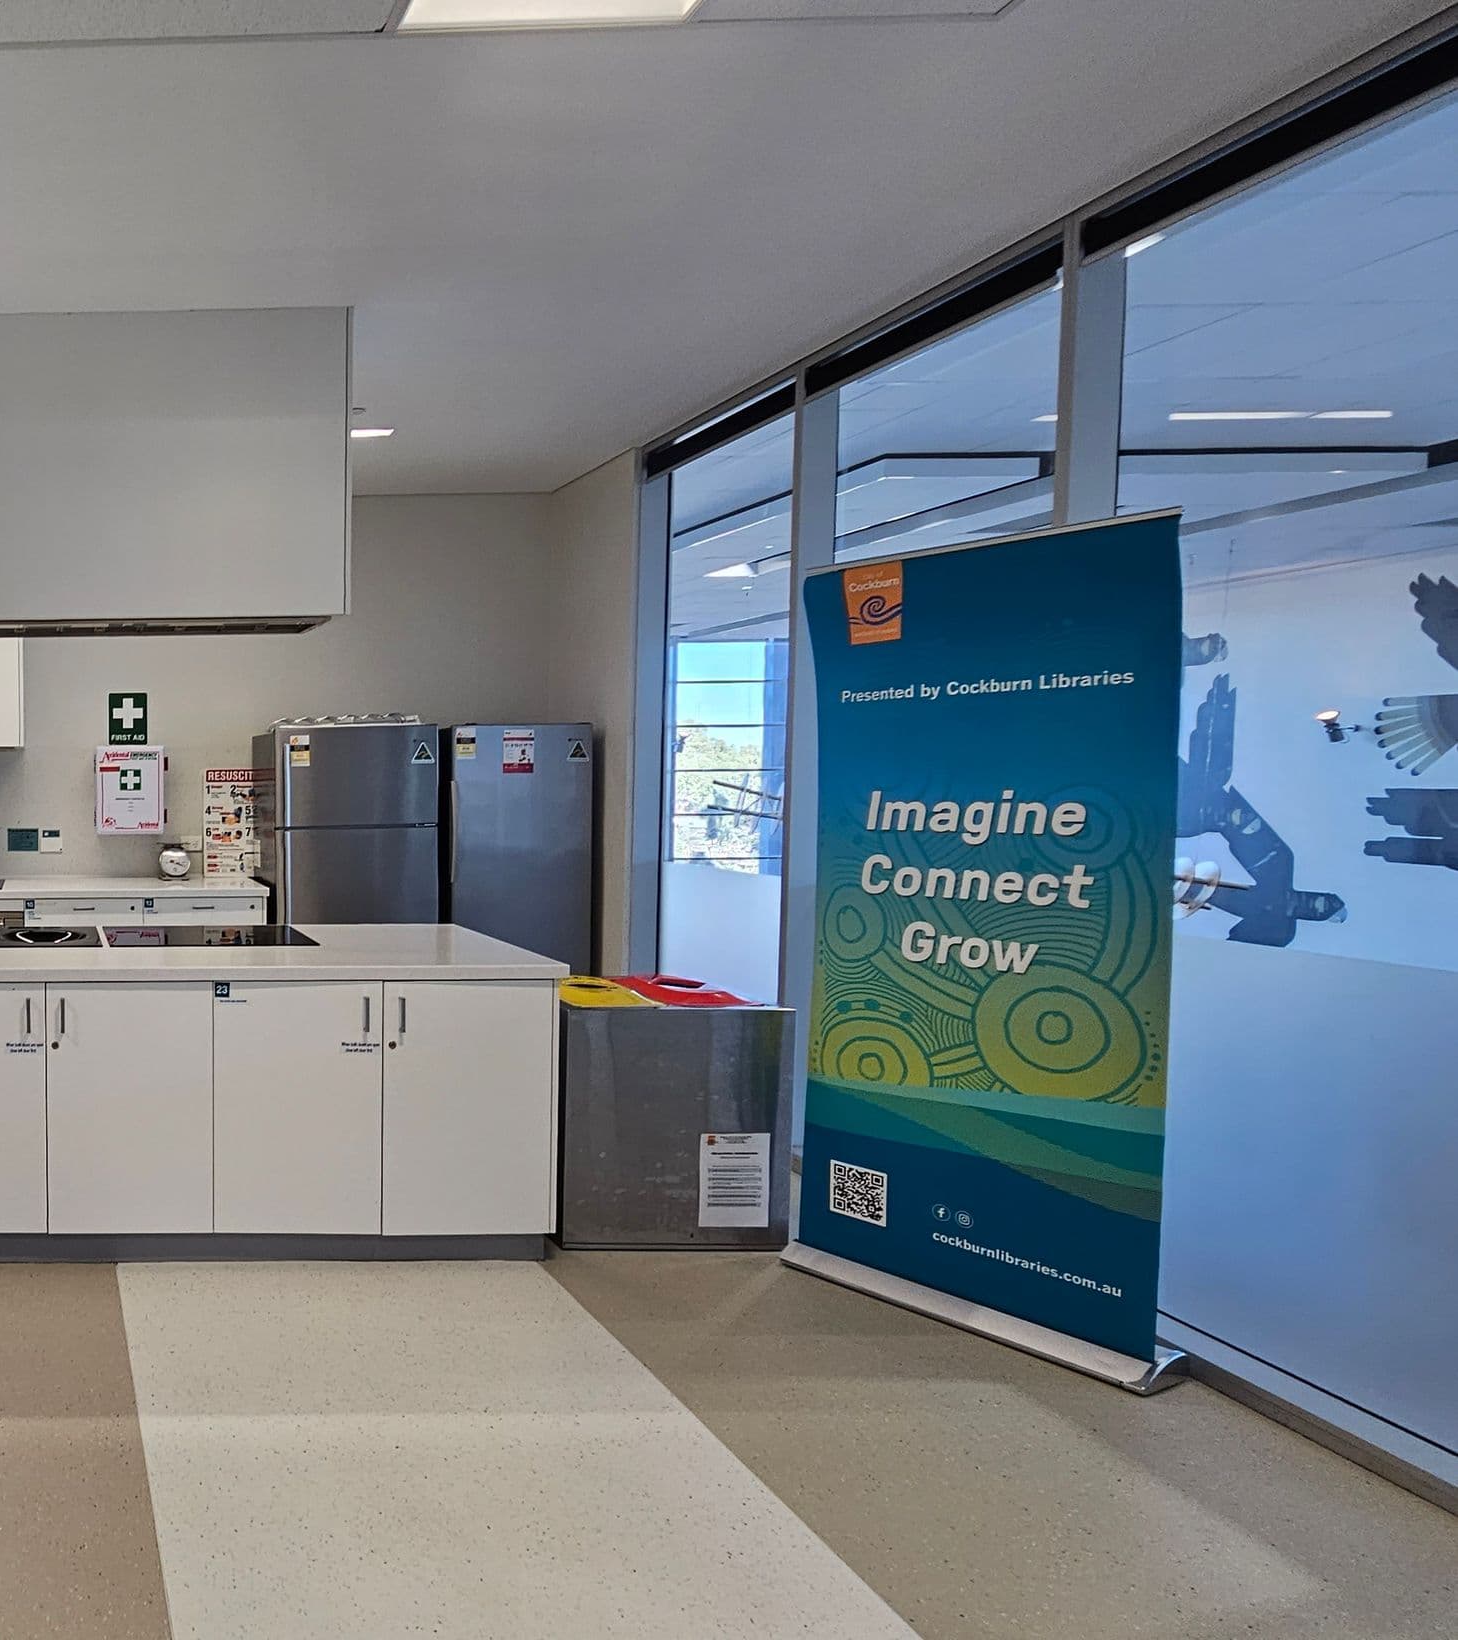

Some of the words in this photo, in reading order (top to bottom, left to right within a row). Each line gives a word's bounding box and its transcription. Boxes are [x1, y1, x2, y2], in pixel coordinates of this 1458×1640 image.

[848, 577, 900, 592] Cockburn
[841, 684, 915, 703] Presented
[920, 683, 941, 700] by
[946, 679, 1032, 696] Cockburn
[1039, 670, 1135, 690] Libraries
[205, 785, 211, 795] 1
[230, 785, 238, 796] 2
[205, 805, 212, 815] 4
[865, 789, 1088, 845] Imagine
[206, 827, 212, 837] 6
[861, 854, 1095, 909] Connect
[901, 921, 1040, 975] Grow
[216, 985, 228, 994] 23
[932, 1231, 1122, 1298] cockburnlibraries.com.au
